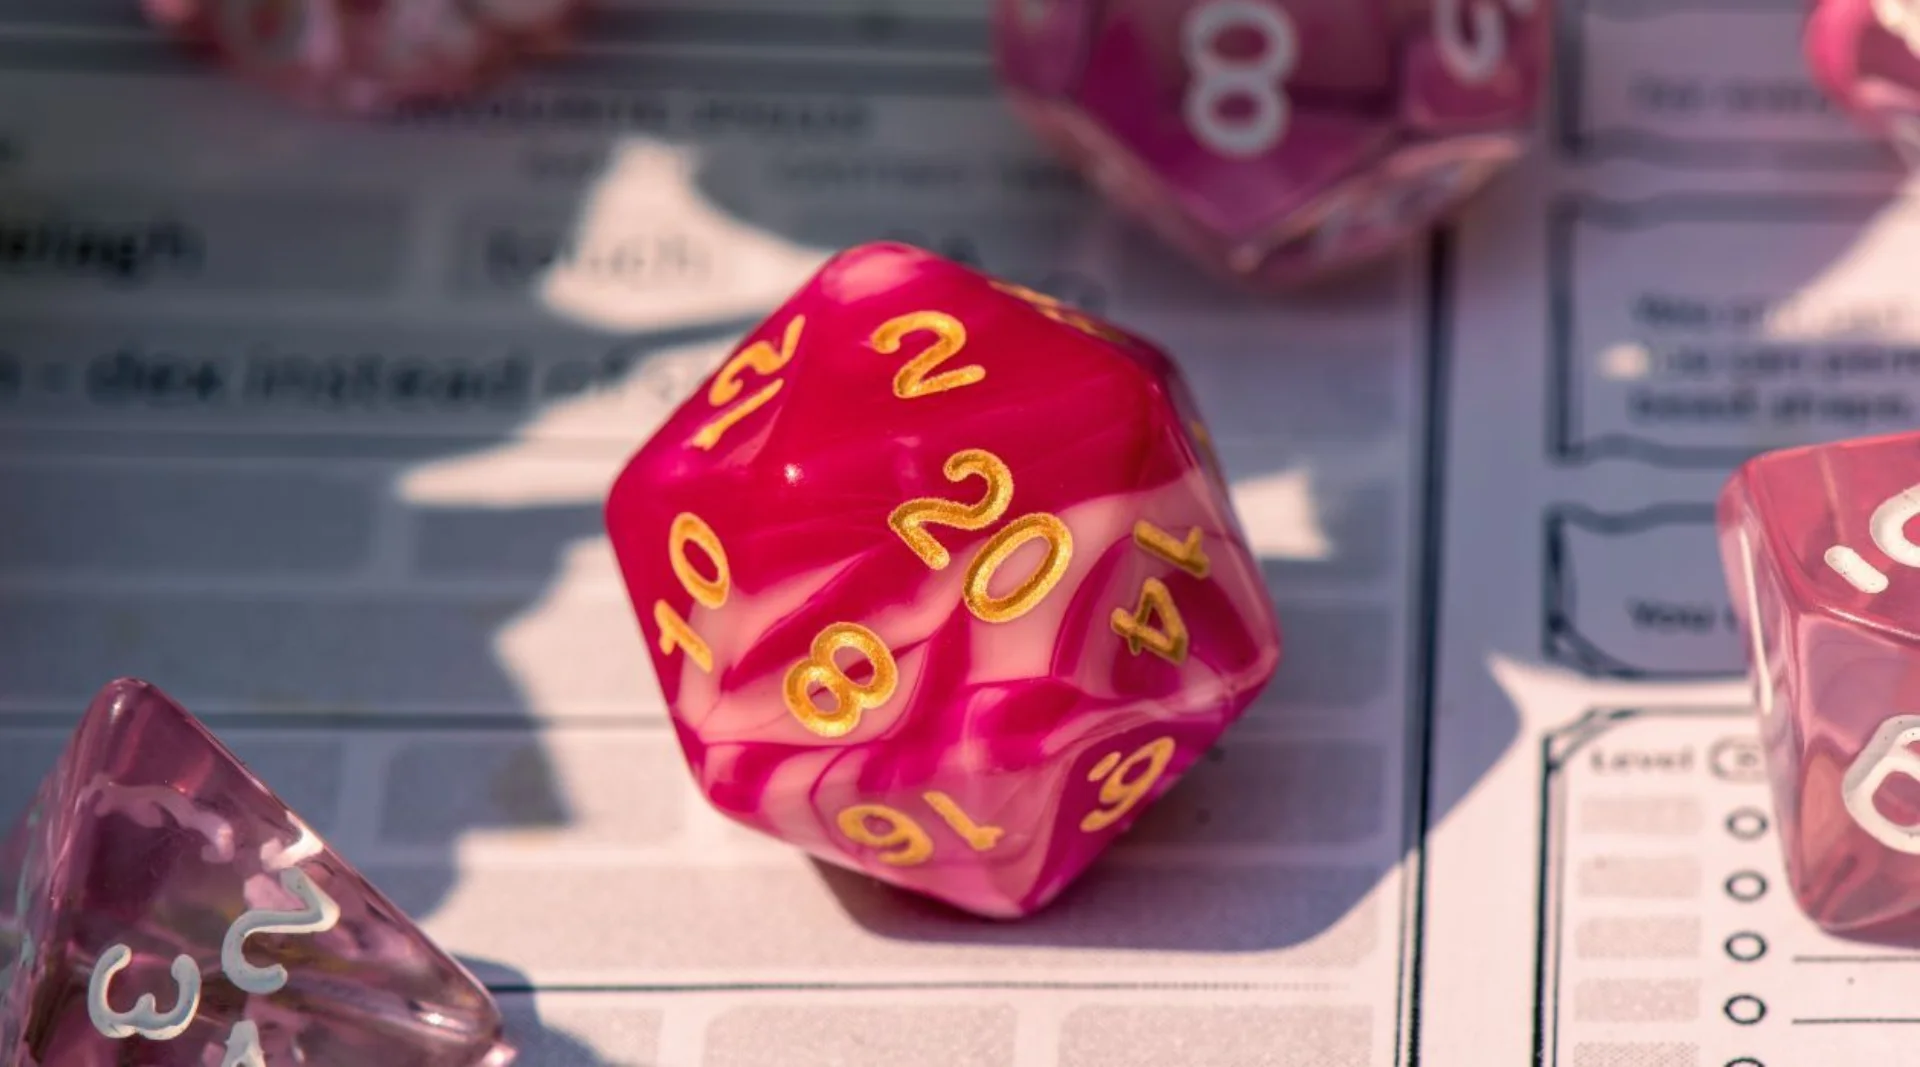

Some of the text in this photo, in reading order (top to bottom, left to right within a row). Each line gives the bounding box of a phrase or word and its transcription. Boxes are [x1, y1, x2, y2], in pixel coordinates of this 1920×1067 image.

[1182, 0, 1294, 155] 8
[691, 315, 806, 450] 12
[871, 310, 986, 398] 2
[654, 511, 731, 673] 10
[888, 448, 1073, 622] 20
[1110, 520, 1209, 665] 14
[782, 622, 898, 738] 8
[1590, 746, 1694, 780] Level
[838, 791, 1004, 865] 16
[88, 943, 202, 1041] 3
